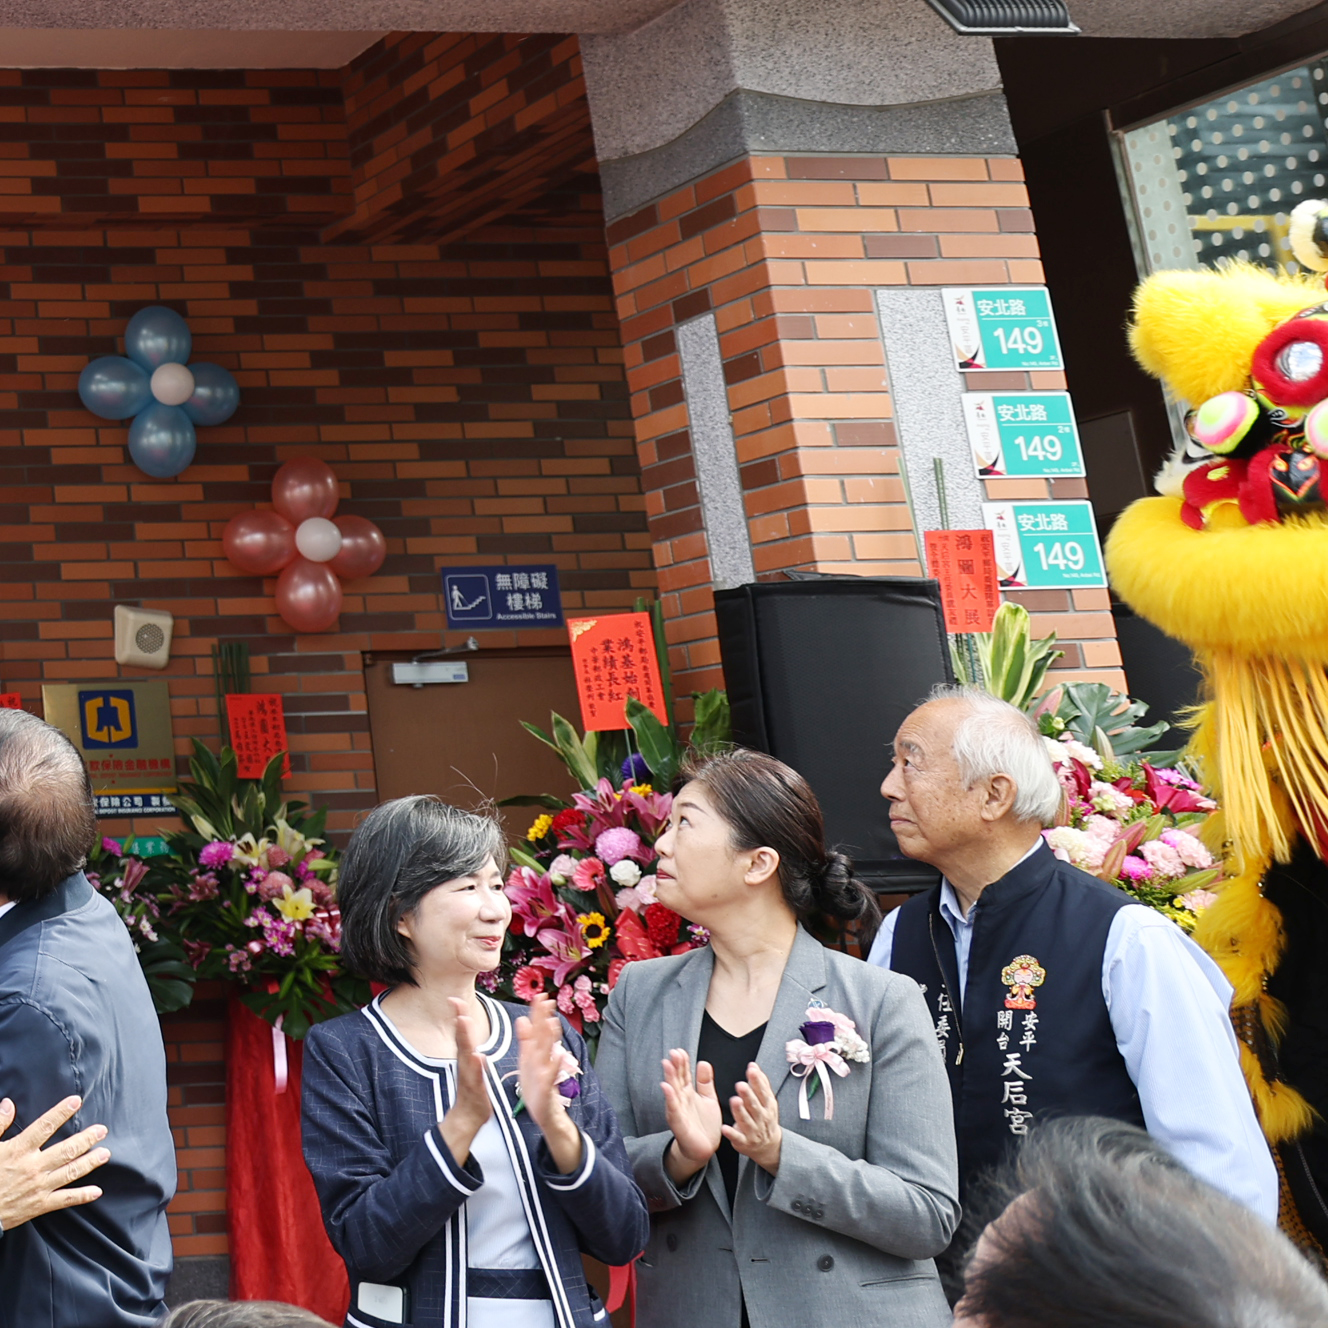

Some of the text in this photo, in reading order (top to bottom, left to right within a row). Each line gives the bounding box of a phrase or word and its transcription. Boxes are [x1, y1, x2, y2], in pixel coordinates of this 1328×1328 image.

[976, 299, 1027, 317] 安北路
[993, 326, 1043, 355] 149
[997, 403, 1048, 422] 安北路
[1014, 435, 1063, 462] 149
[1017, 513, 1069, 531] 安北路
[1033, 541, 1085, 571] 149
[495, 572, 549, 591] 無障礙
[955, 534, 981, 625] 鴻圖大展
[506, 592, 543, 611] 樓梯
[600, 638, 625, 703] 業績長紅
[85, 758, 171, 771] 款保險金融機構
[996, 1009, 1014, 1051] 開台
[1019, 1011, 1040, 1053] 安平
[1000, 1052, 1034, 1137] 天后宮
